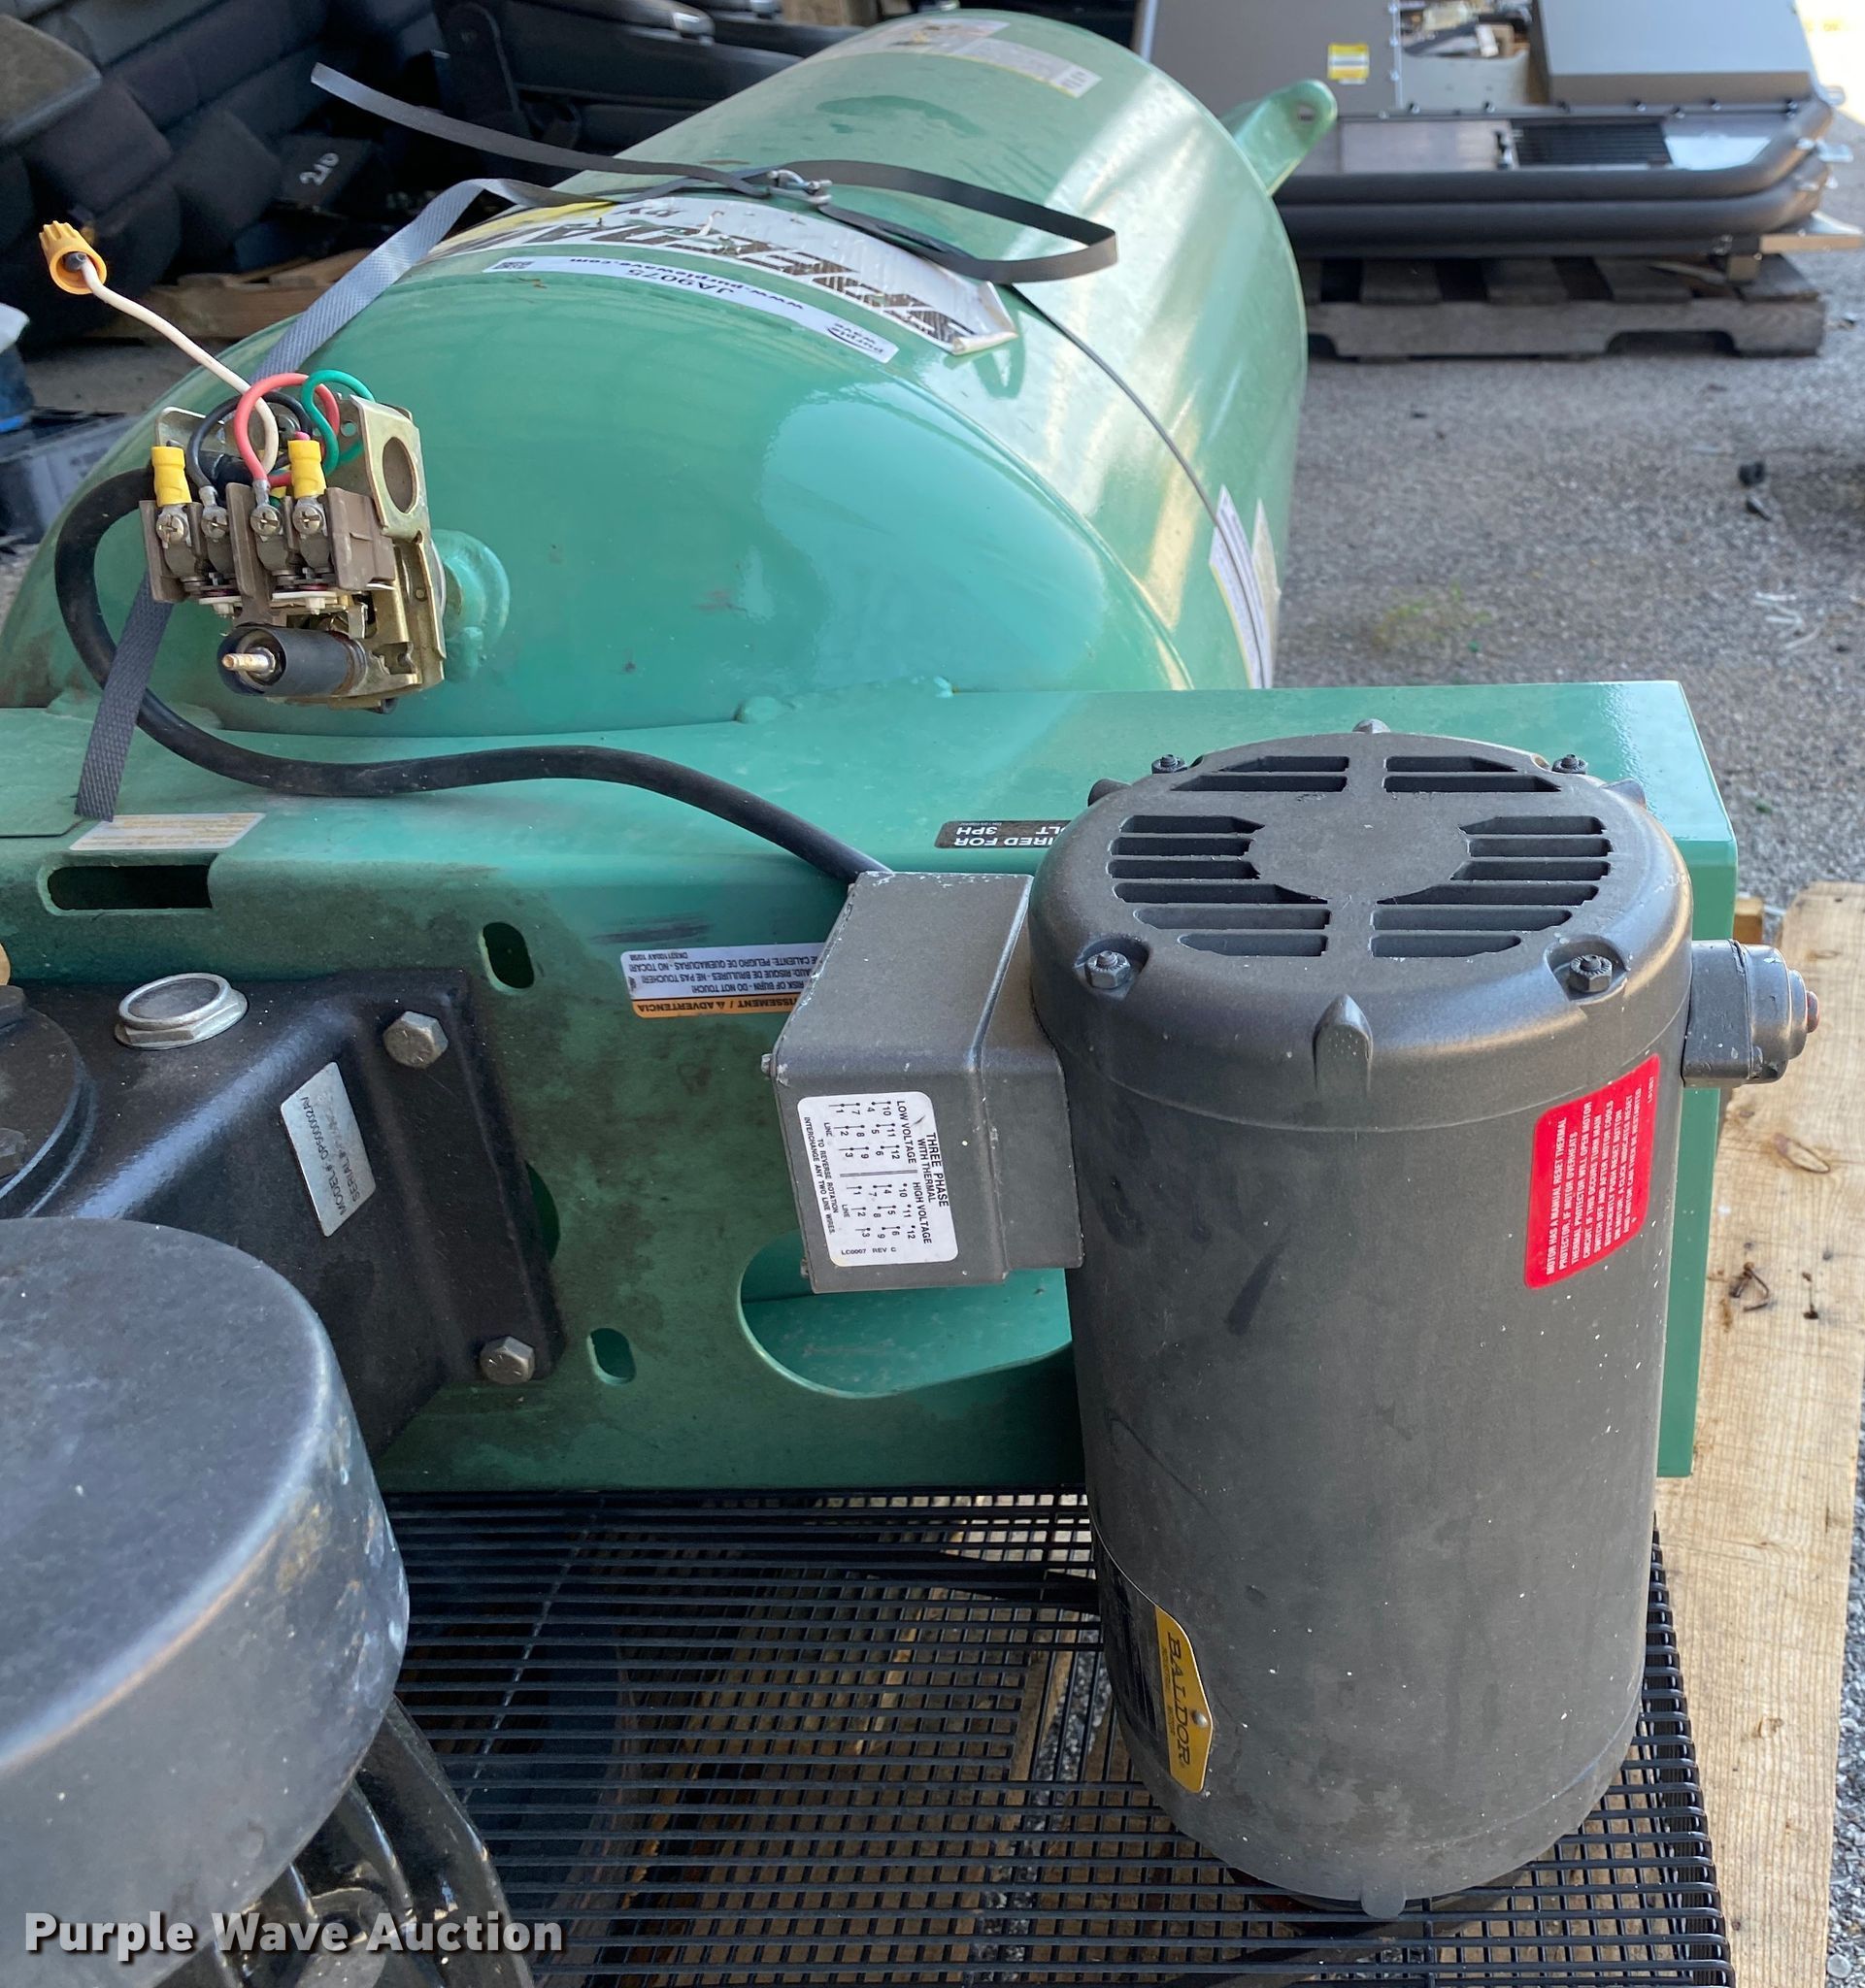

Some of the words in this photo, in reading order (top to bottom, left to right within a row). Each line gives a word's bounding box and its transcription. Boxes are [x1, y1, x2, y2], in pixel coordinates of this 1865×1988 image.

[629, 269, 736, 294] JA9075
[954, 837, 997, 846] FOR
[1004, 837, 1054, 846] IRED
[955, 826, 998, 836] 3PH
[681, 974, 693, 982] PAS
[721, 983, 737, 992] NOT
[638, 1002, 715, 1012] ADVERTENCIA
[738, 998, 798, 1008] TISSEMENT
[897, 1100, 908, 1121] LOW
[1582, 1101, 1592, 1132] MOTOR
[804, 1117, 820, 1162] INTERCHANGE
[817, 1139, 825, 1147] TO
[901, 1124, 916, 1164] VOLTAGE
[917, 1139, 927, 1159] WITH
[1555, 1116, 1567, 1157] THERMAL
[1580, 1132, 1590, 1155] OPEN
[820, 1149, 832, 1179] REVERSE
[1566, 1131, 1579, 1178] OVERHEATS
[1578, 1155, 1588, 1178] WILL
[815, 1164, 823, 1177] ANY
[823, 1122, 832, 1137] LINE
[842, 1205, 850, 1217] LINE
[883, 1107, 891, 1115] 10
[887, 1128, 895, 1138] 11
[891, 1150, 900, 1159] 12
[899, 1188, 908, 1197] 10
[908, 1230, 916, 1240] 12
[921, 1161, 936, 1203] THERMAL
[926, 1132, 942, 1167] THREE
[934, 1173, 949, 1207] PHASE
[1552, 1157, 1564, 1184] RESET
[818, 1179, 827, 1195] TWO
[826, 1180, 839, 1213] ROTATION
[913, 1181, 923, 1204] HIGH
[1563, 1178, 1574, 1209] MOTOR
[821, 1196, 830, 1211] LINE
[1550, 1184, 1561, 1219] MANUAL
[1574, 1177, 1586, 1226] PROTECTOR
[917, 1206, 932, 1243] VOLTAGE
[1549, 1227, 1558, 1244] HAS
[1571, 1225, 1582, 1264] THERMAL
[1546, 1244, 1556, 1275] MOTOR
[1167, 1633, 1190, 1765] BALDOR
